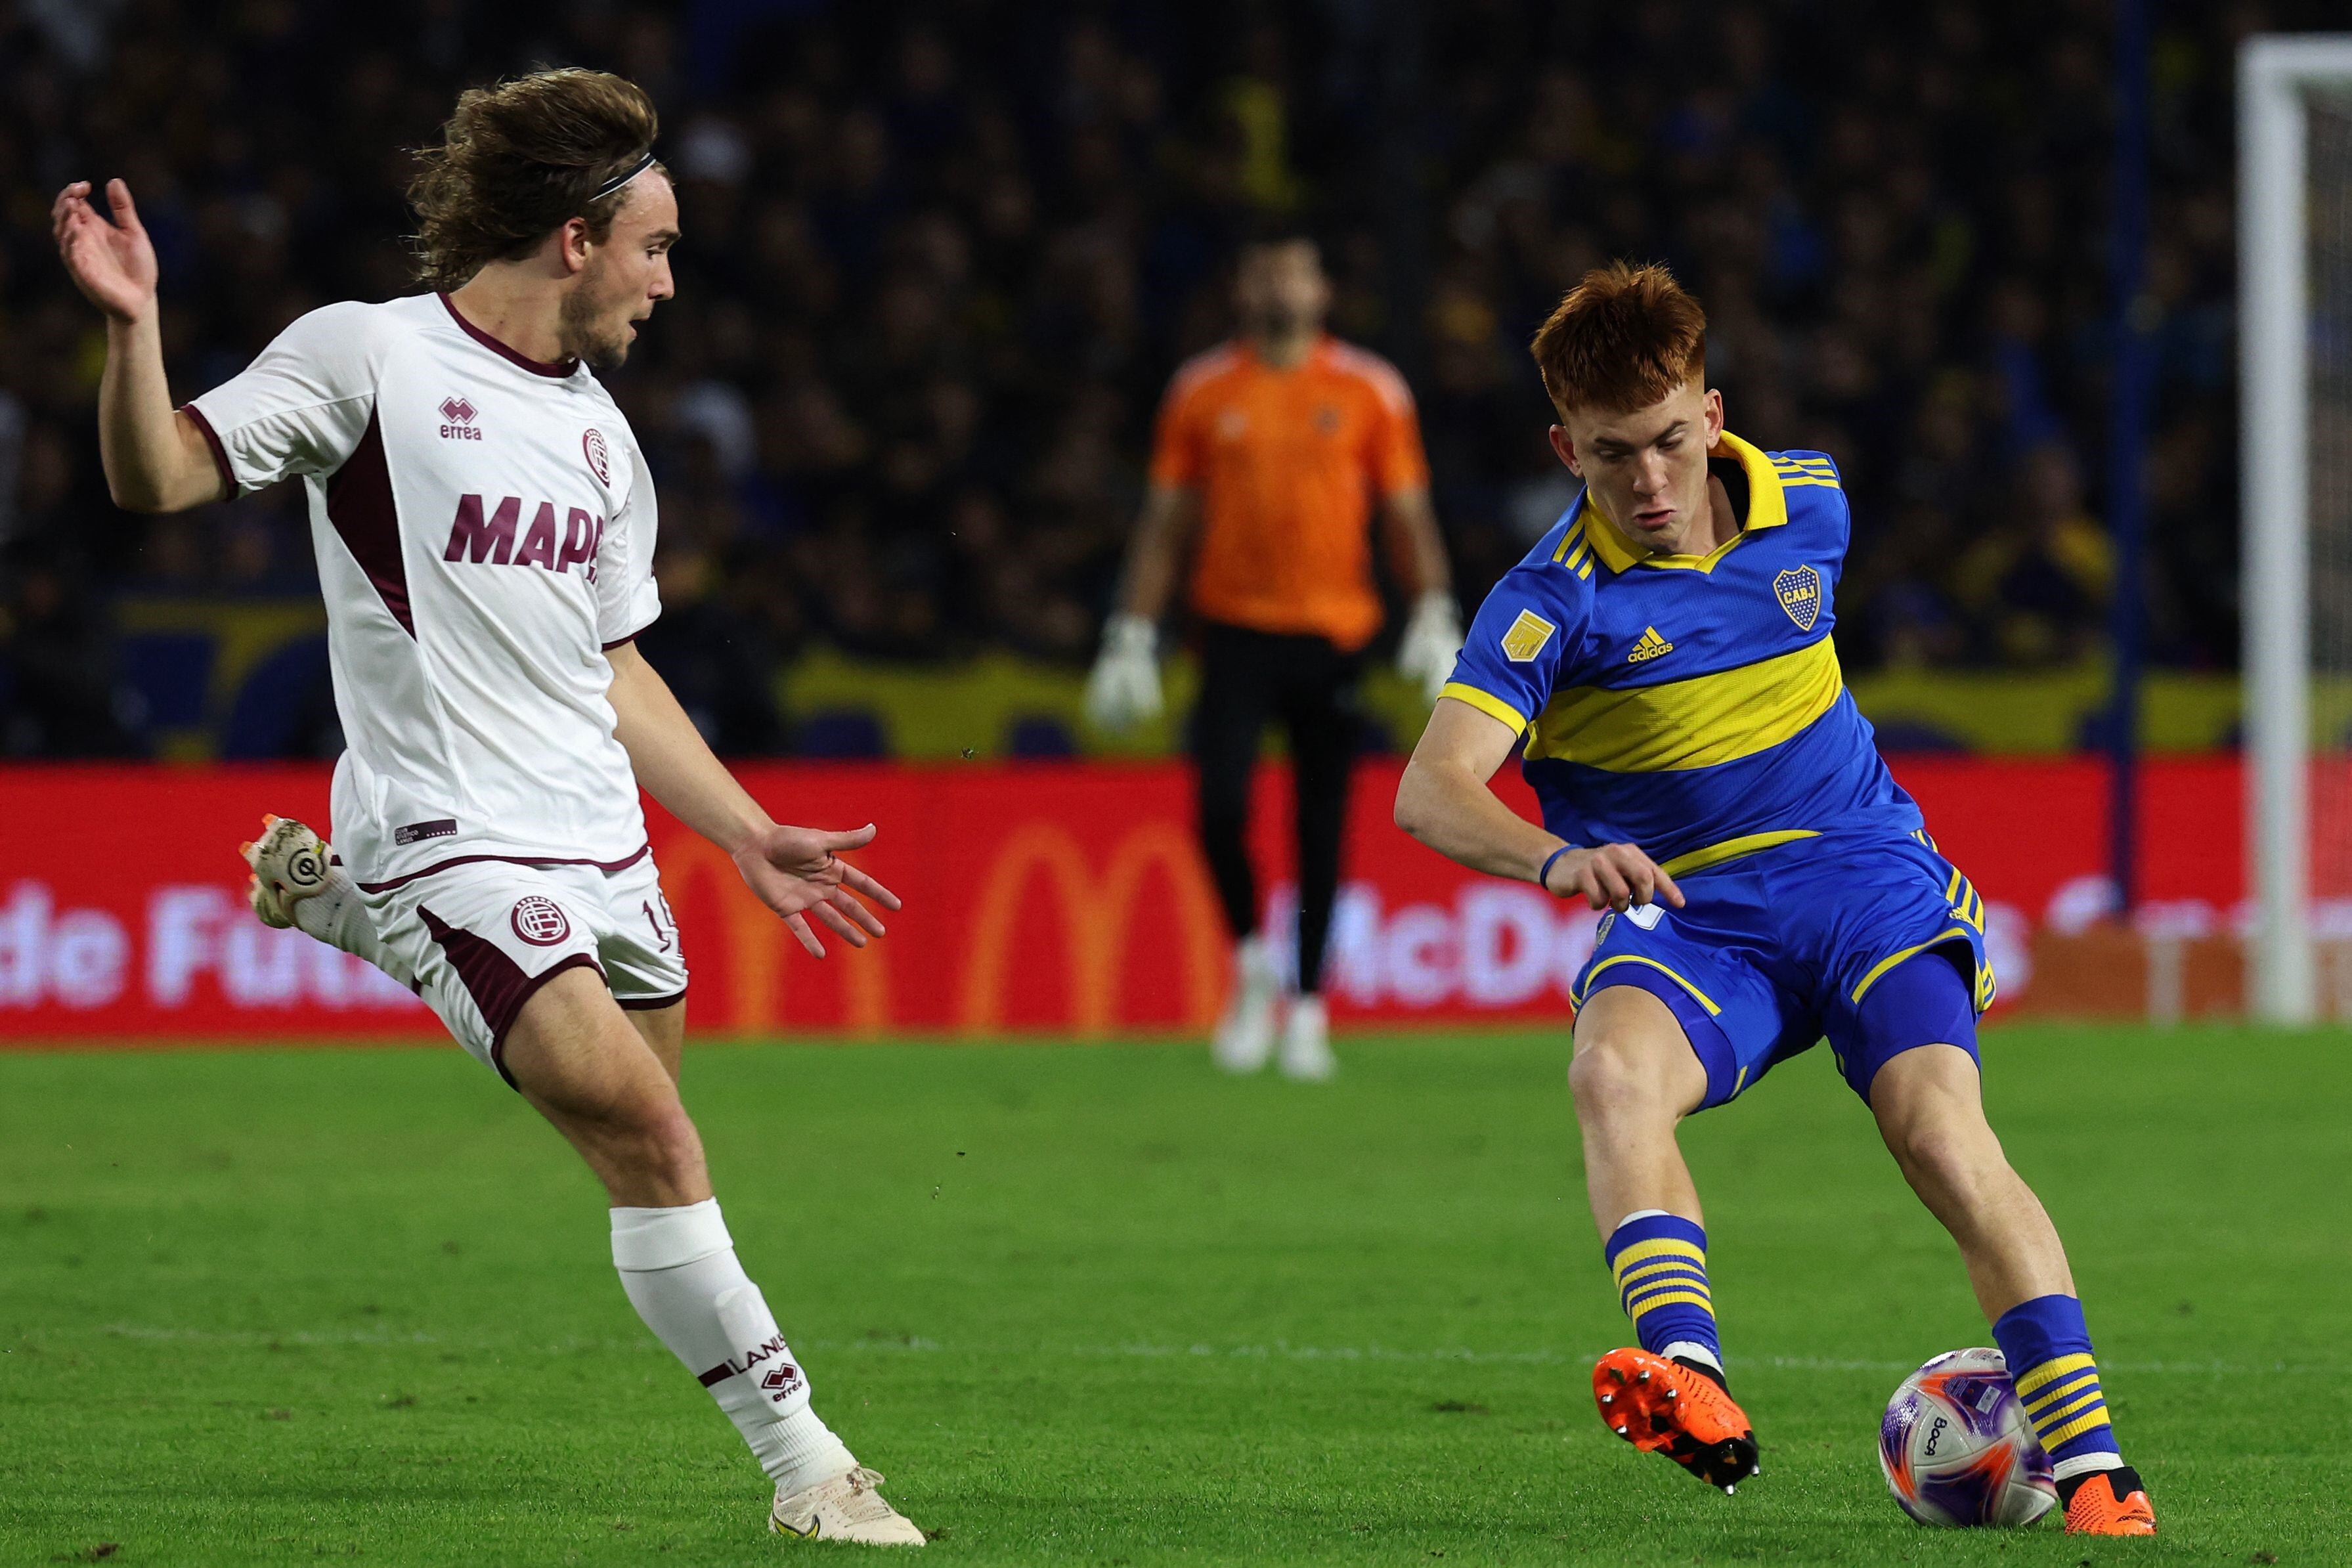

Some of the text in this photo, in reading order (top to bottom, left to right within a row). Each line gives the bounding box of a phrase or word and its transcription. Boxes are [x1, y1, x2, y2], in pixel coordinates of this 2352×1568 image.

[440, 424, 483, 441] errea
[1783, 585, 1816, 604] CABJ
[1627, 642, 1674, 663] adidas
[772, 1380, 803, 1403] errea
